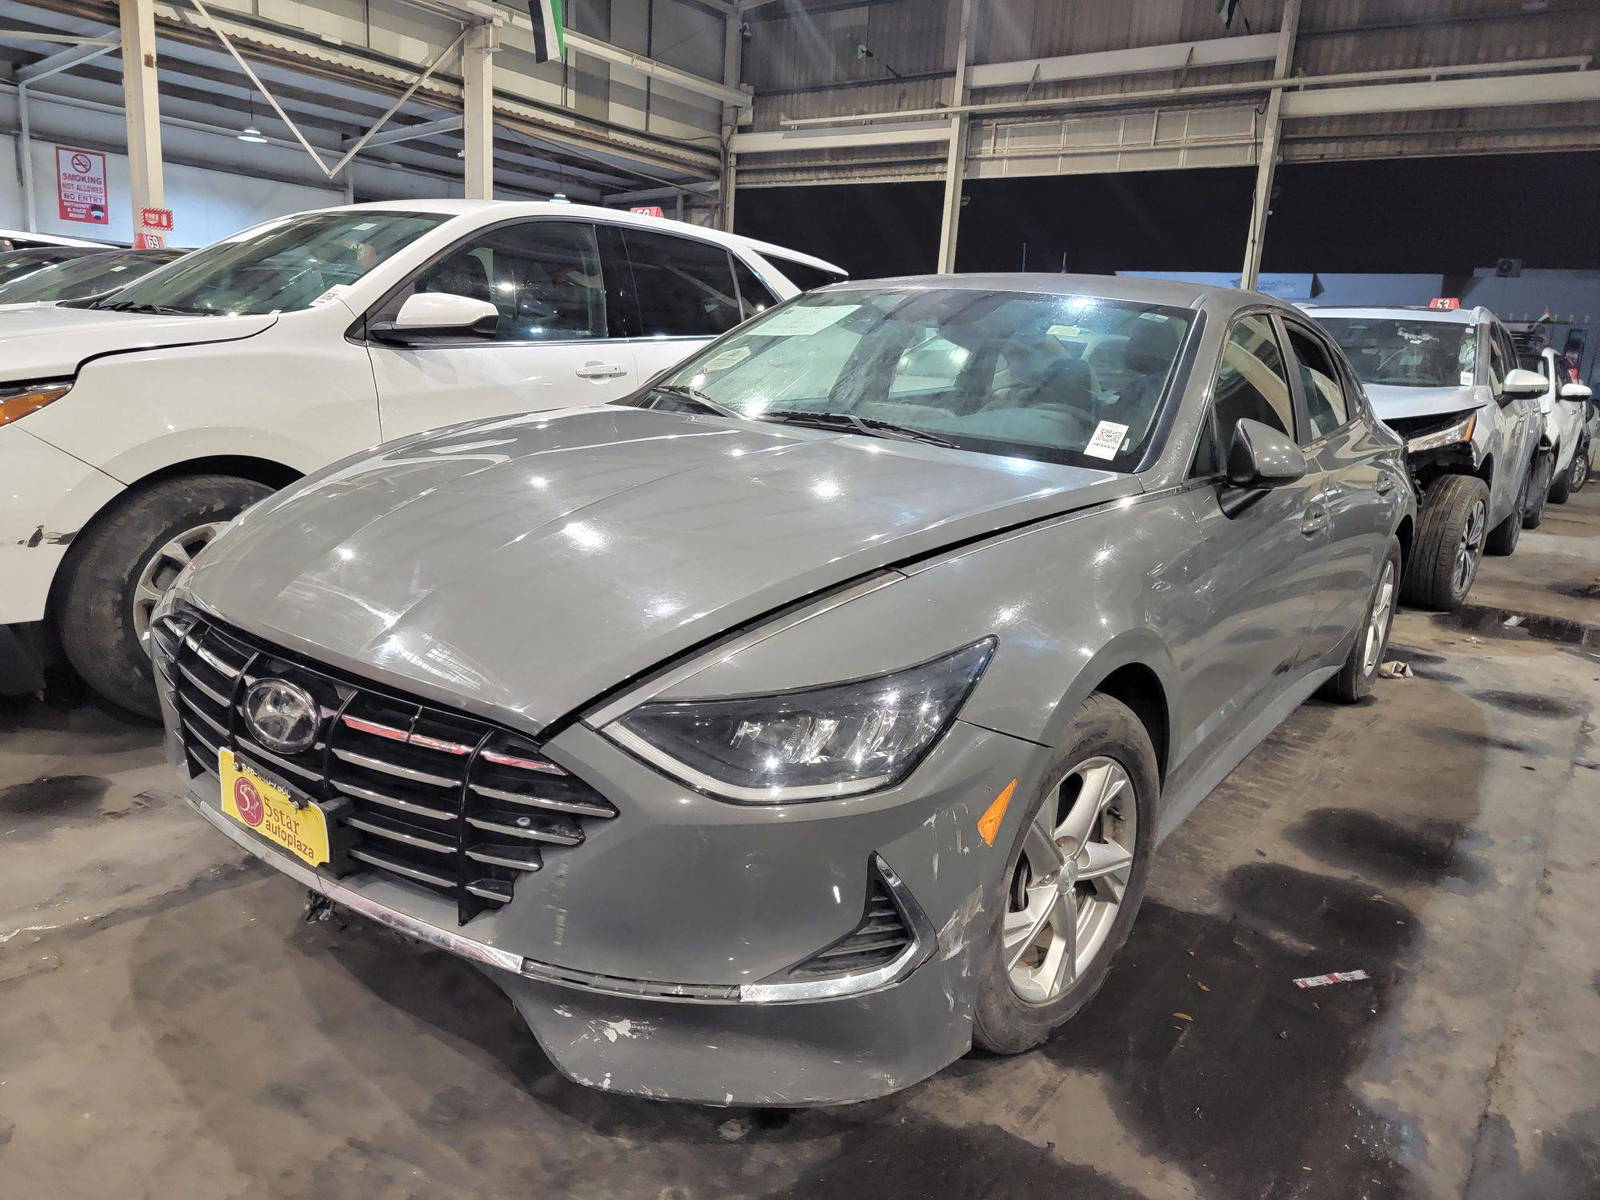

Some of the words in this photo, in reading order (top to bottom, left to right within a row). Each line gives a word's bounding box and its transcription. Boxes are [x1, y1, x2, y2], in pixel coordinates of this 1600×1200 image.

[62, 173, 102, 185] SMOKING
[76, 184, 103, 194] ALLOWED
[63, 192, 75, 200] NO
[77, 194, 103, 204] ENTRY
[265, 819, 315, 860] autoplaza
